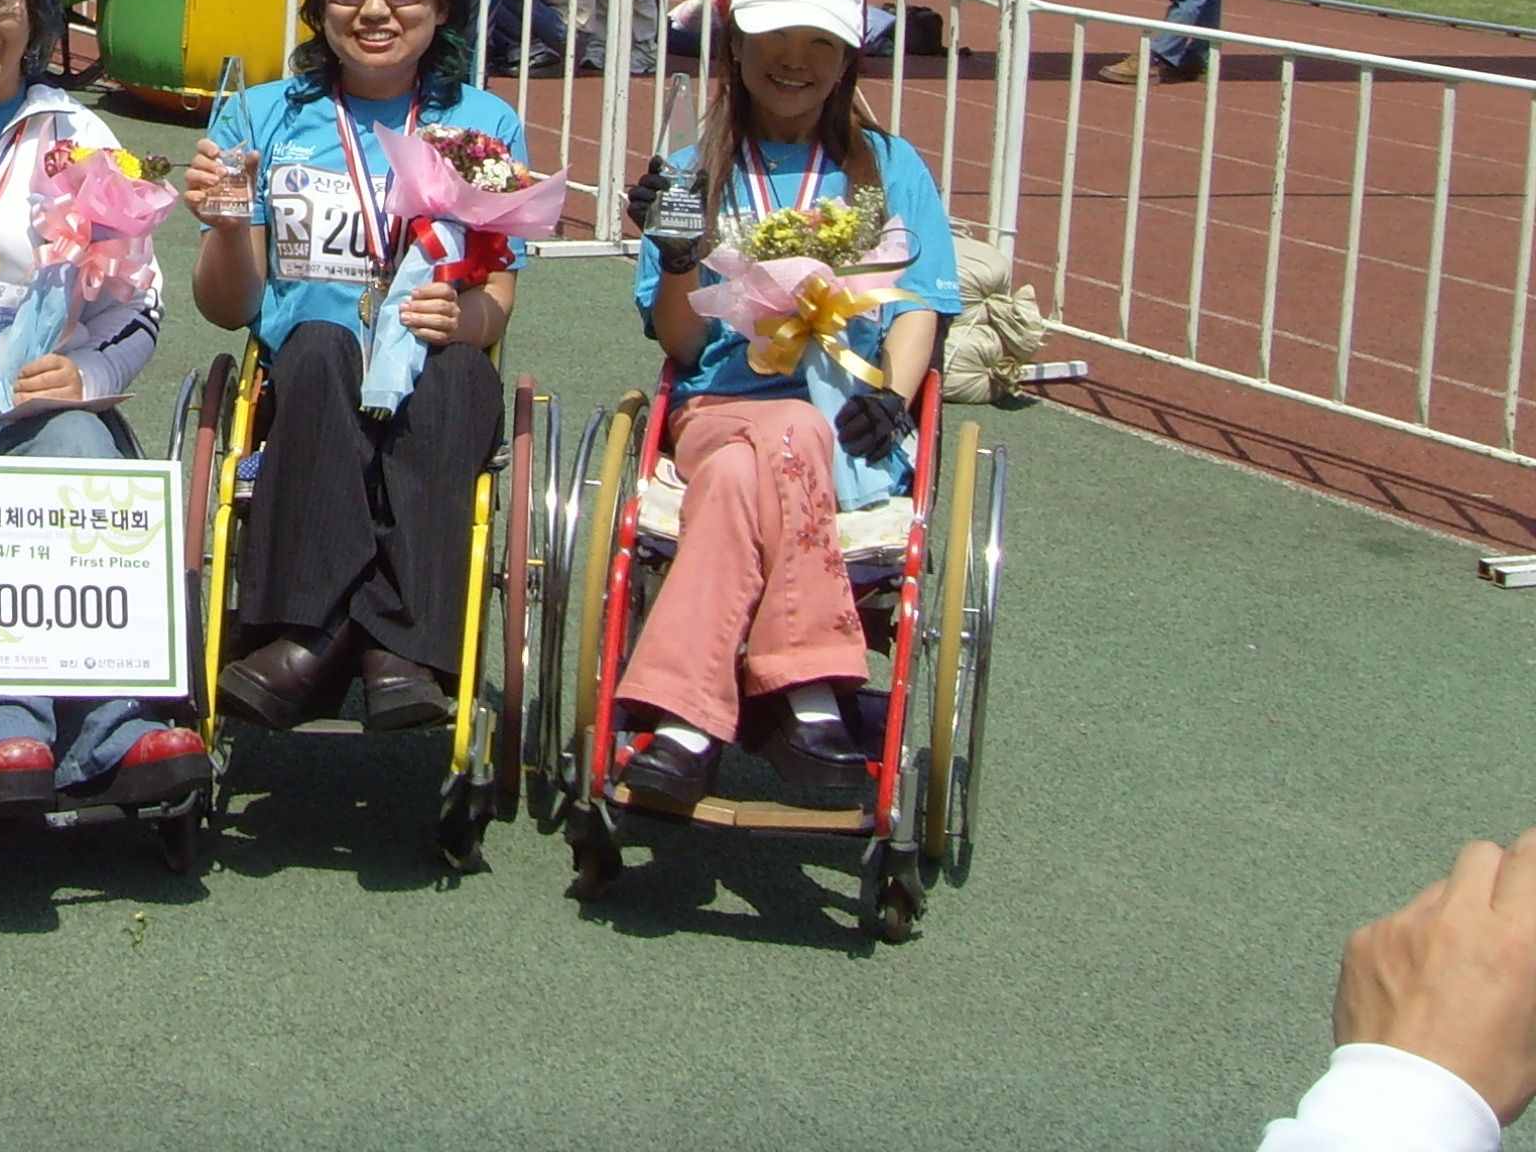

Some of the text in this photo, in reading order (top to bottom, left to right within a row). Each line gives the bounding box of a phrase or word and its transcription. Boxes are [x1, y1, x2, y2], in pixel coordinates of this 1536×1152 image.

[272, 198, 309, 241] R
[28, 544, 51, 561] 1위
[69, 555, 151, 570] First Place
